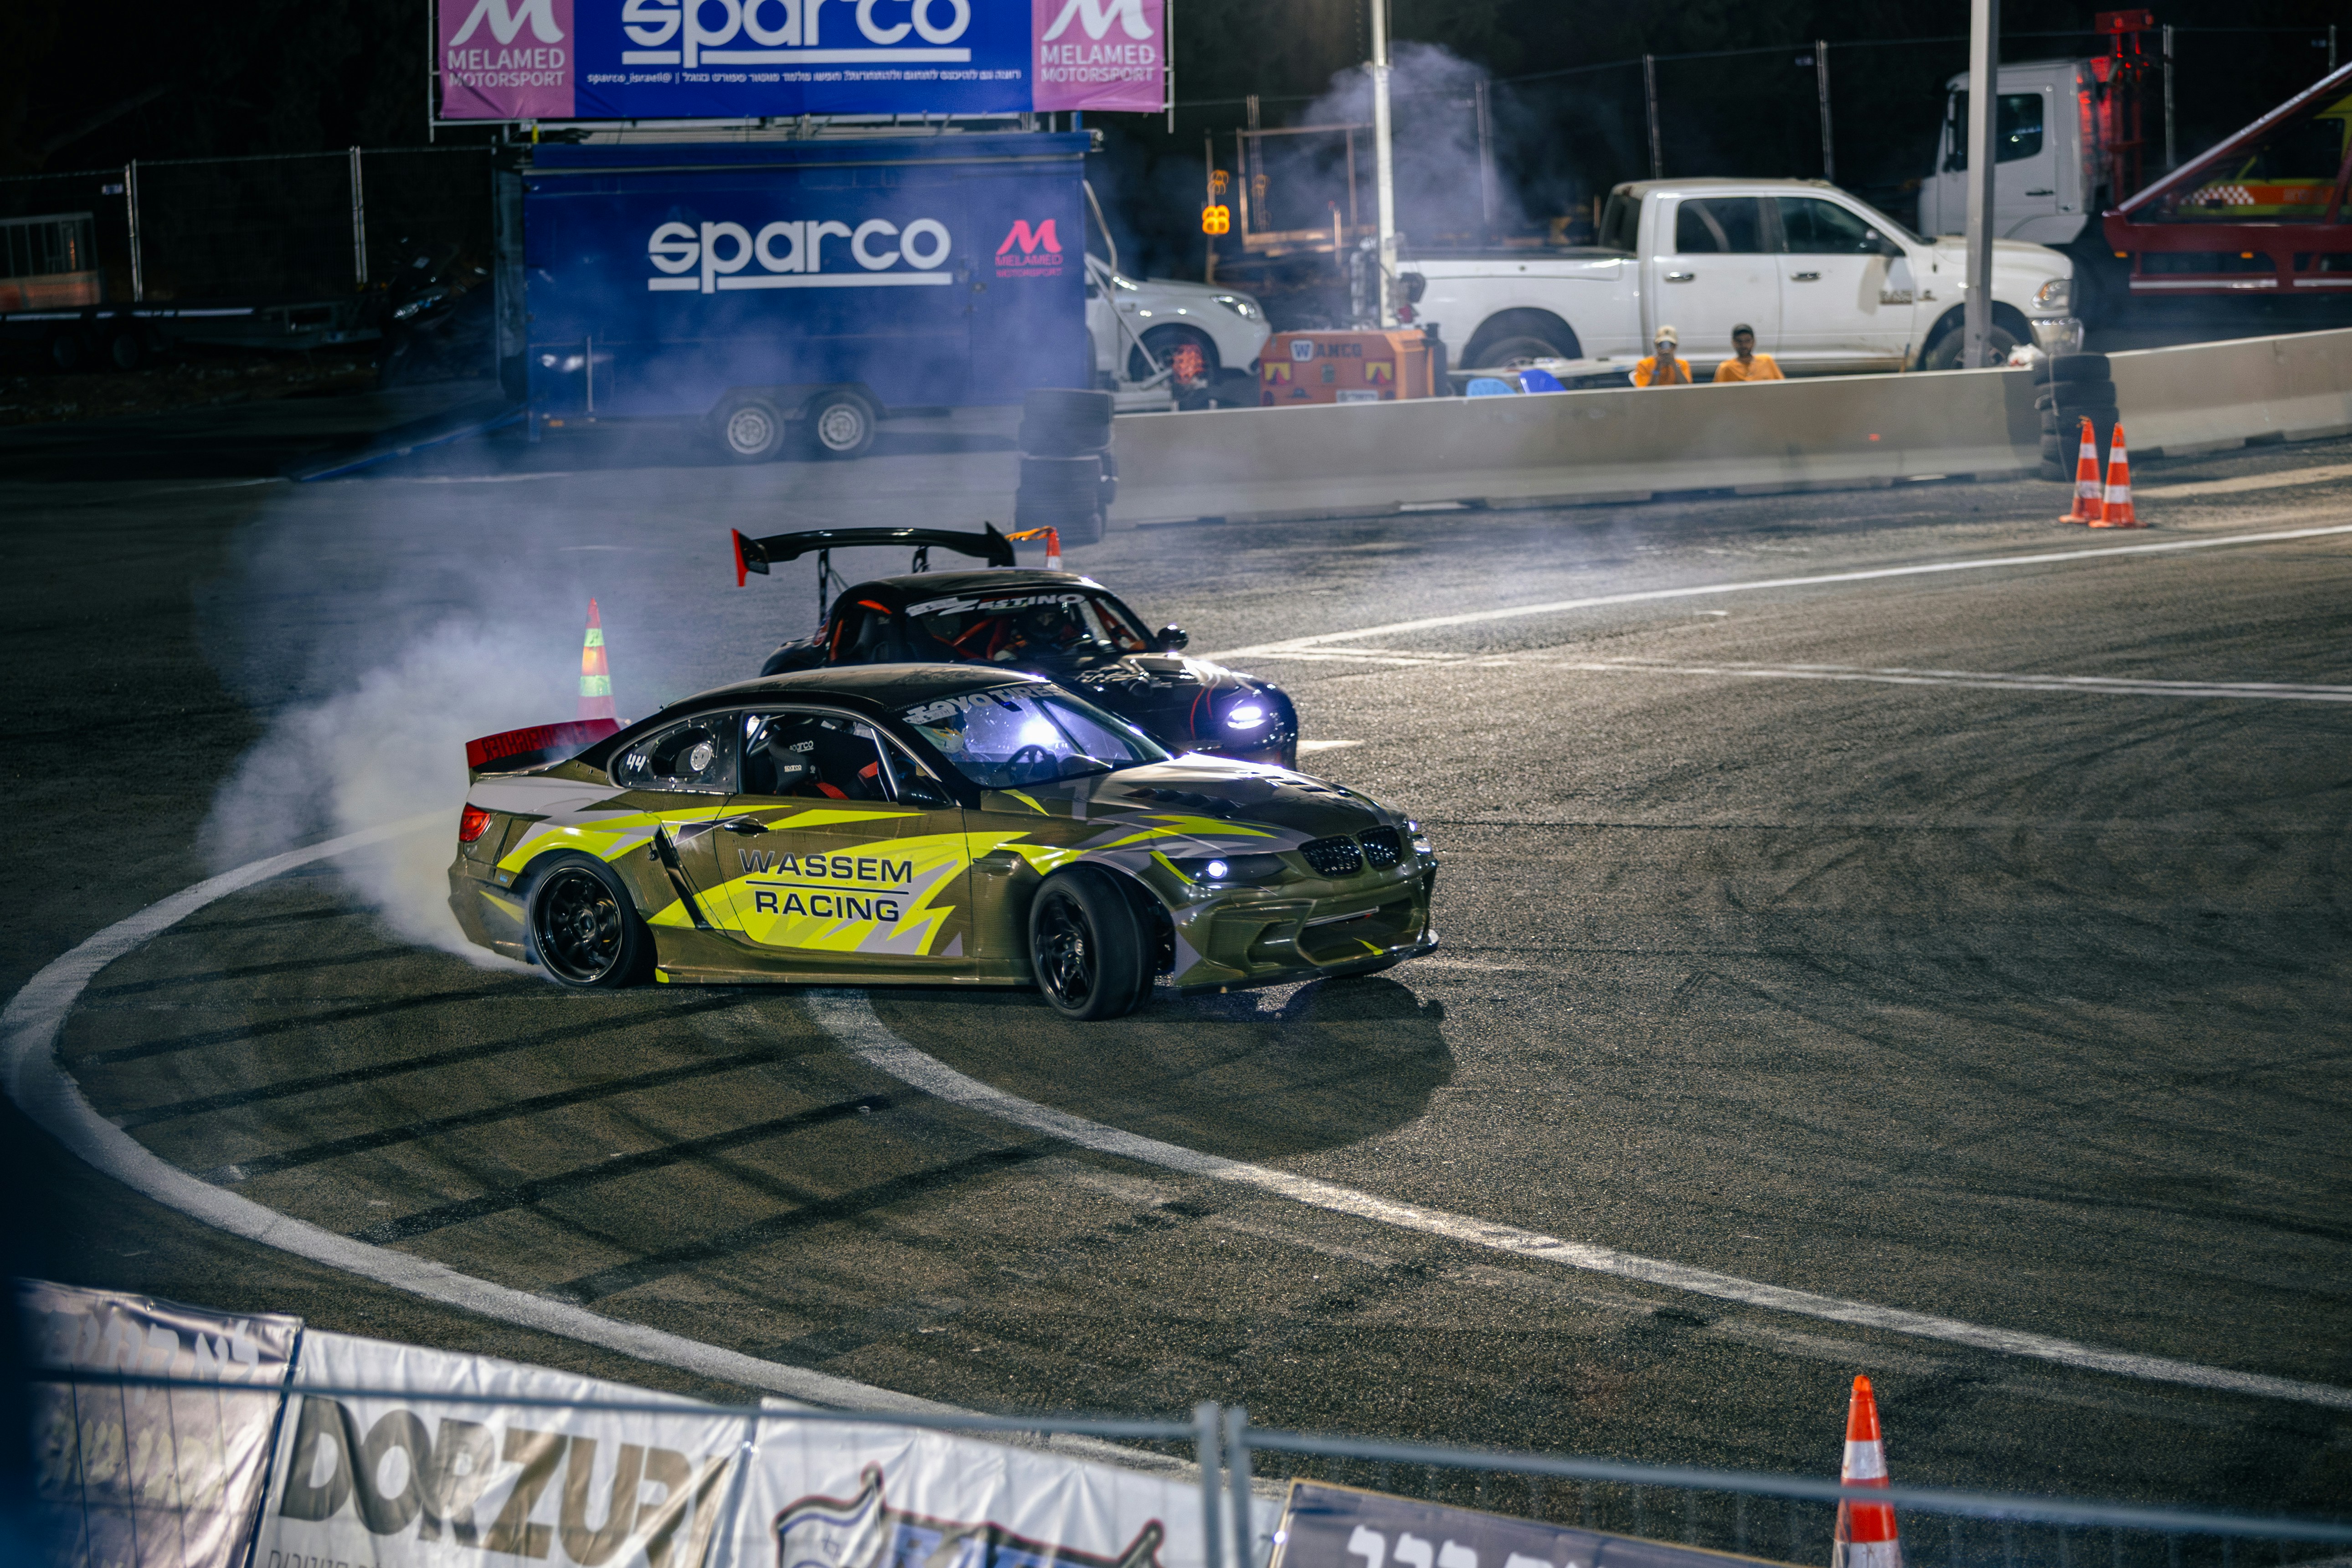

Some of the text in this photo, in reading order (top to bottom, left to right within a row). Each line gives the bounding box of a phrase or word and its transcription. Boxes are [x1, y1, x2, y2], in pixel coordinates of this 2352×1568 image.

[622, 0, 970, 68] sparco
[448, 48, 565, 70] MELAMED
[1041, 44, 1155, 66] MELAMED
[449, 71, 565, 87] MOTORSPORT
[1042, 67, 1154, 82] MOTORSPORT
[648, 218, 952, 293] sparco
[938, 594, 1086, 616] ZESTINO
[627, 753, 646, 772] 44
[738, 848, 912, 883] WASSEM
[754, 890, 900, 923] RACING
